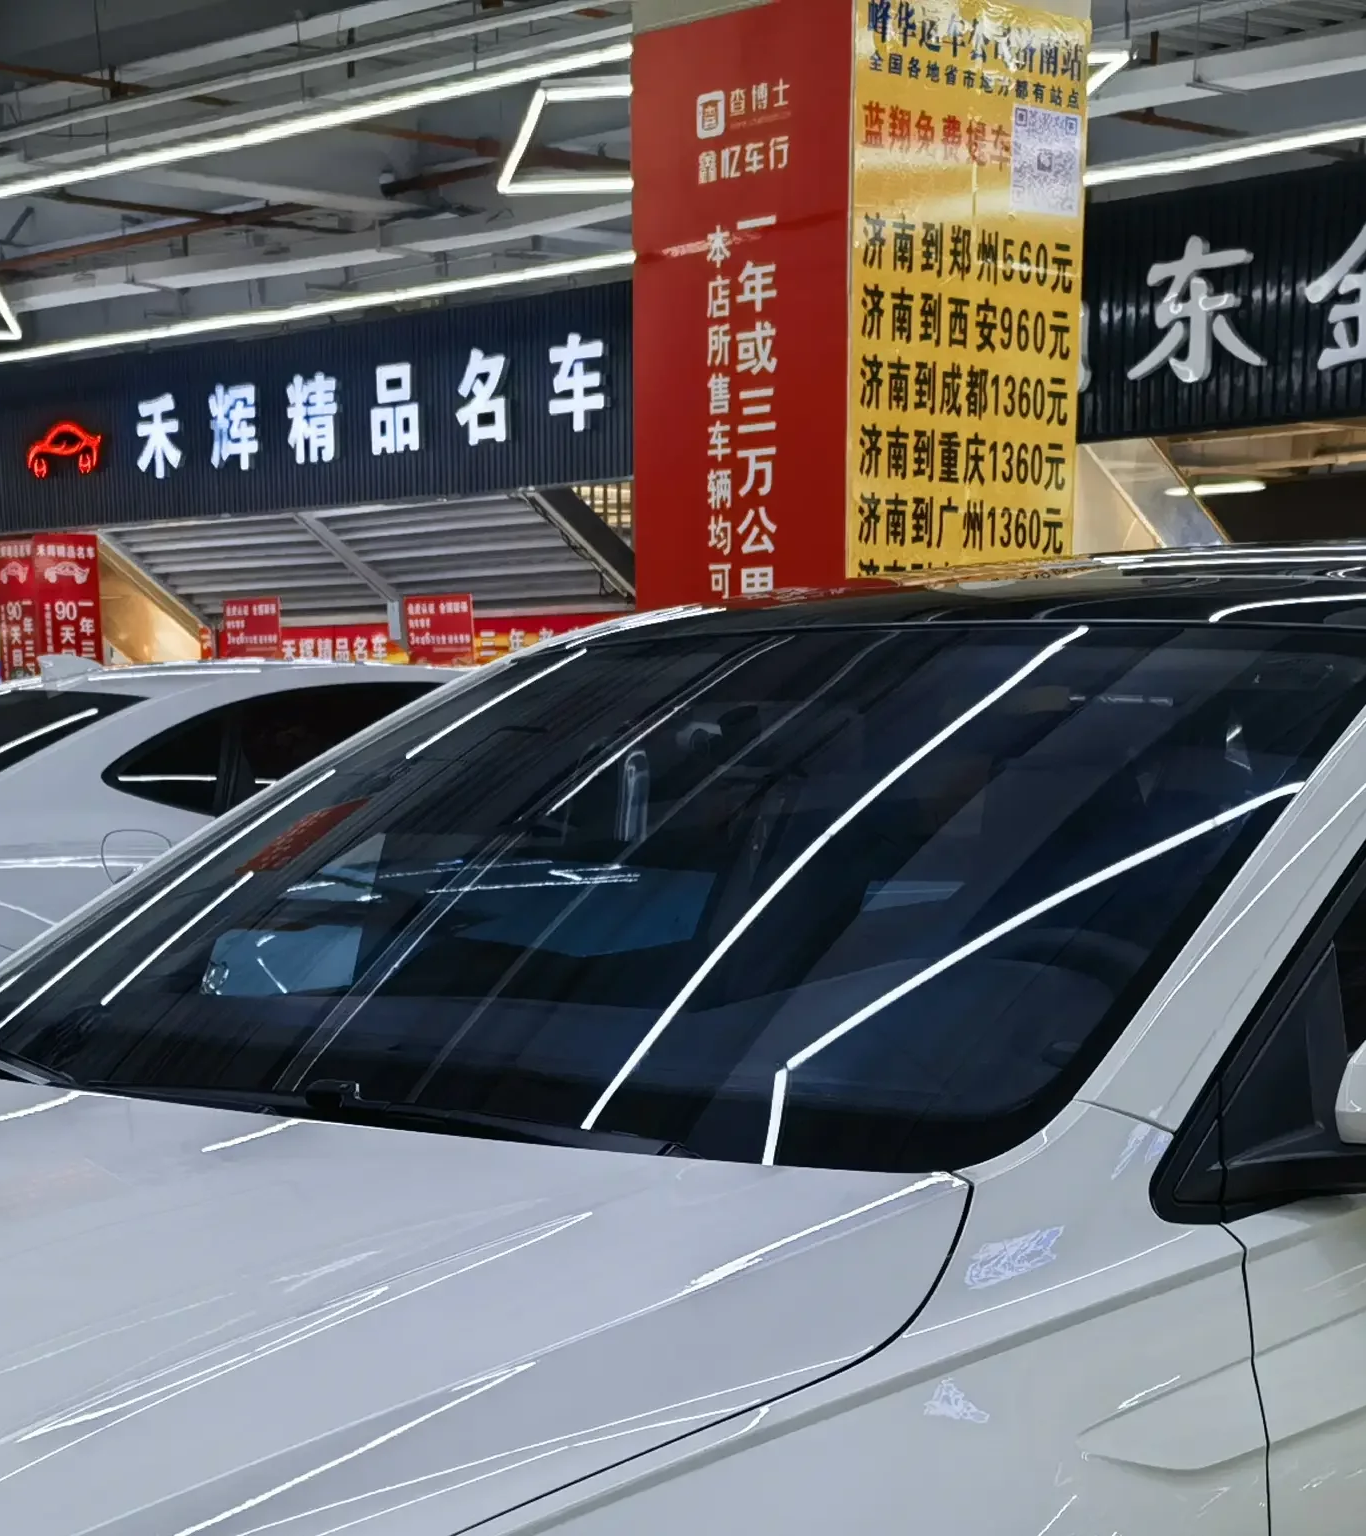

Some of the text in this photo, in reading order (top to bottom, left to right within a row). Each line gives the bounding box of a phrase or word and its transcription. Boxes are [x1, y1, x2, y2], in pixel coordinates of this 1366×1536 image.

[863, 212, 1073, 294] 济南到郑州560元
[861, 283, 1071, 361] 济南到西安960元
[136, 333, 604, 478] 禾辉精品名车
[707, 225, 732, 599] 本店所售车辆均可
[860, 353, 1068, 427] 济南到成都1360元
[858, 423, 1066, 491] 济南到重庆1360元
[858, 492, 1063, 555] 济南到广州1360元
